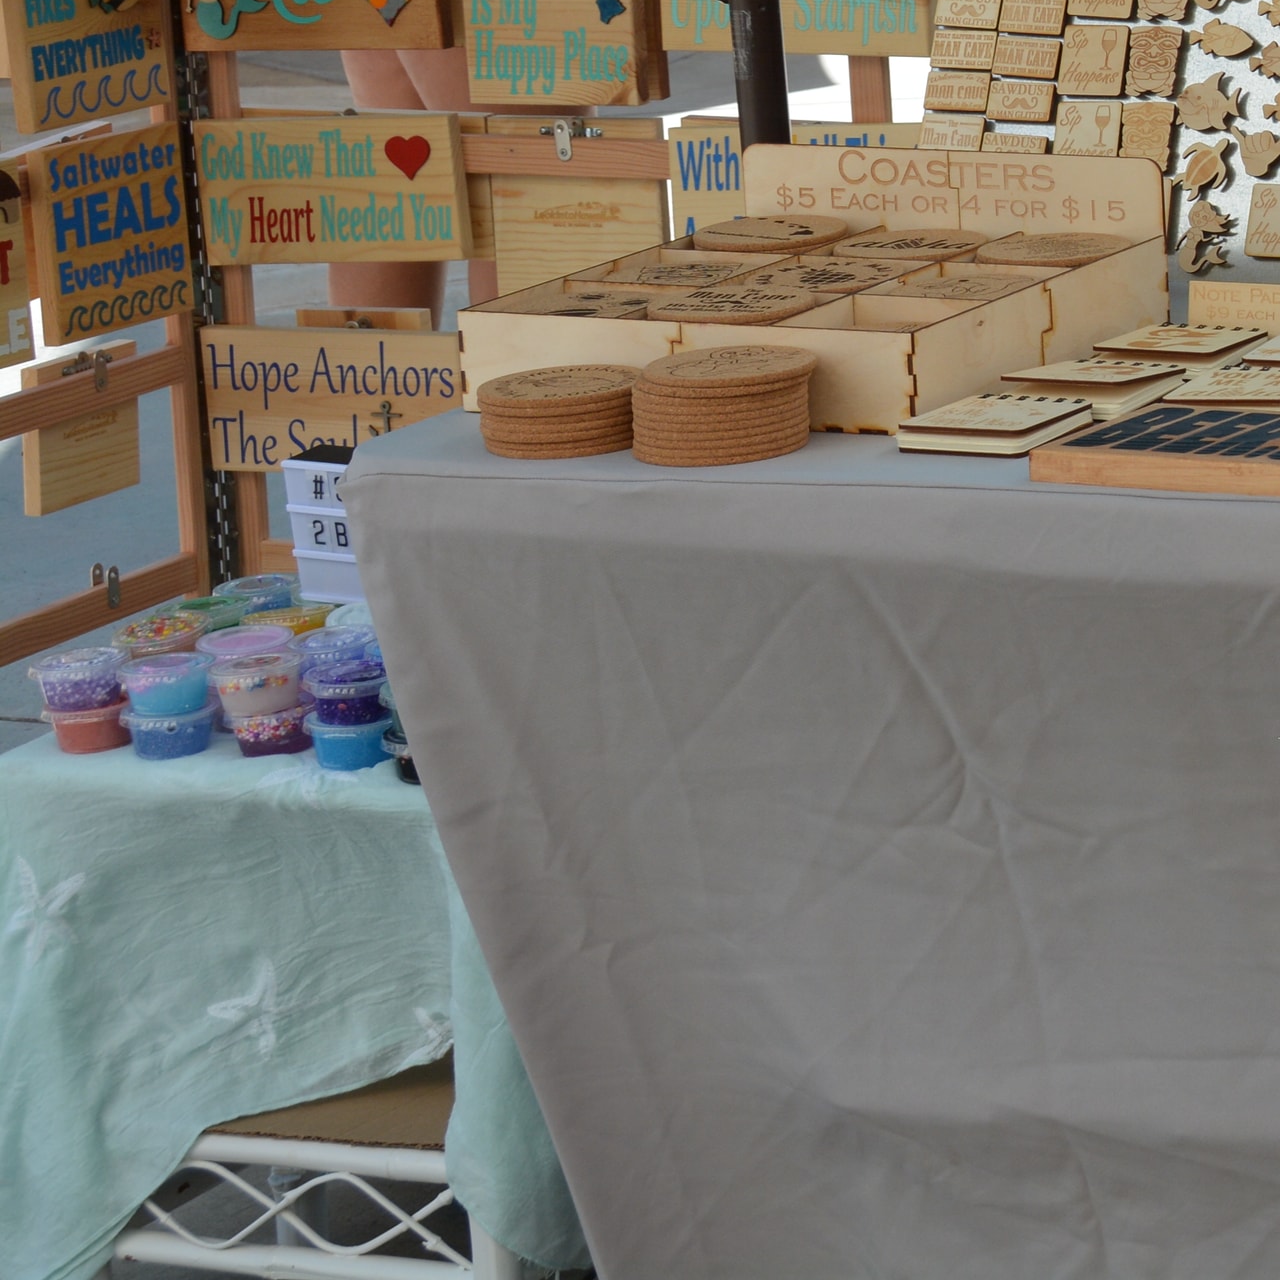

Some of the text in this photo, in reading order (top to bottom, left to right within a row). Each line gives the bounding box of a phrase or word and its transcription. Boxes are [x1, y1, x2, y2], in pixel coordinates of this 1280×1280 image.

[32, 26, 144, 82] EVERYTHING
[475, 27, 629, 96] Happy Place
[49, 142, 175, 192] Saltwater
[202, 129, 375, 180] God Knew That
[53, 175, 181, 253] HEALS
[210, 193, 454, 258] My Heart Needed You
[776, 184, 1126, 223] $5 EACH OR 4 FOR $15
[59, 242, 184, 295] Everything
[207, 341, 454, 409] Hope Anchors
[211, 410, 277, 466] The
